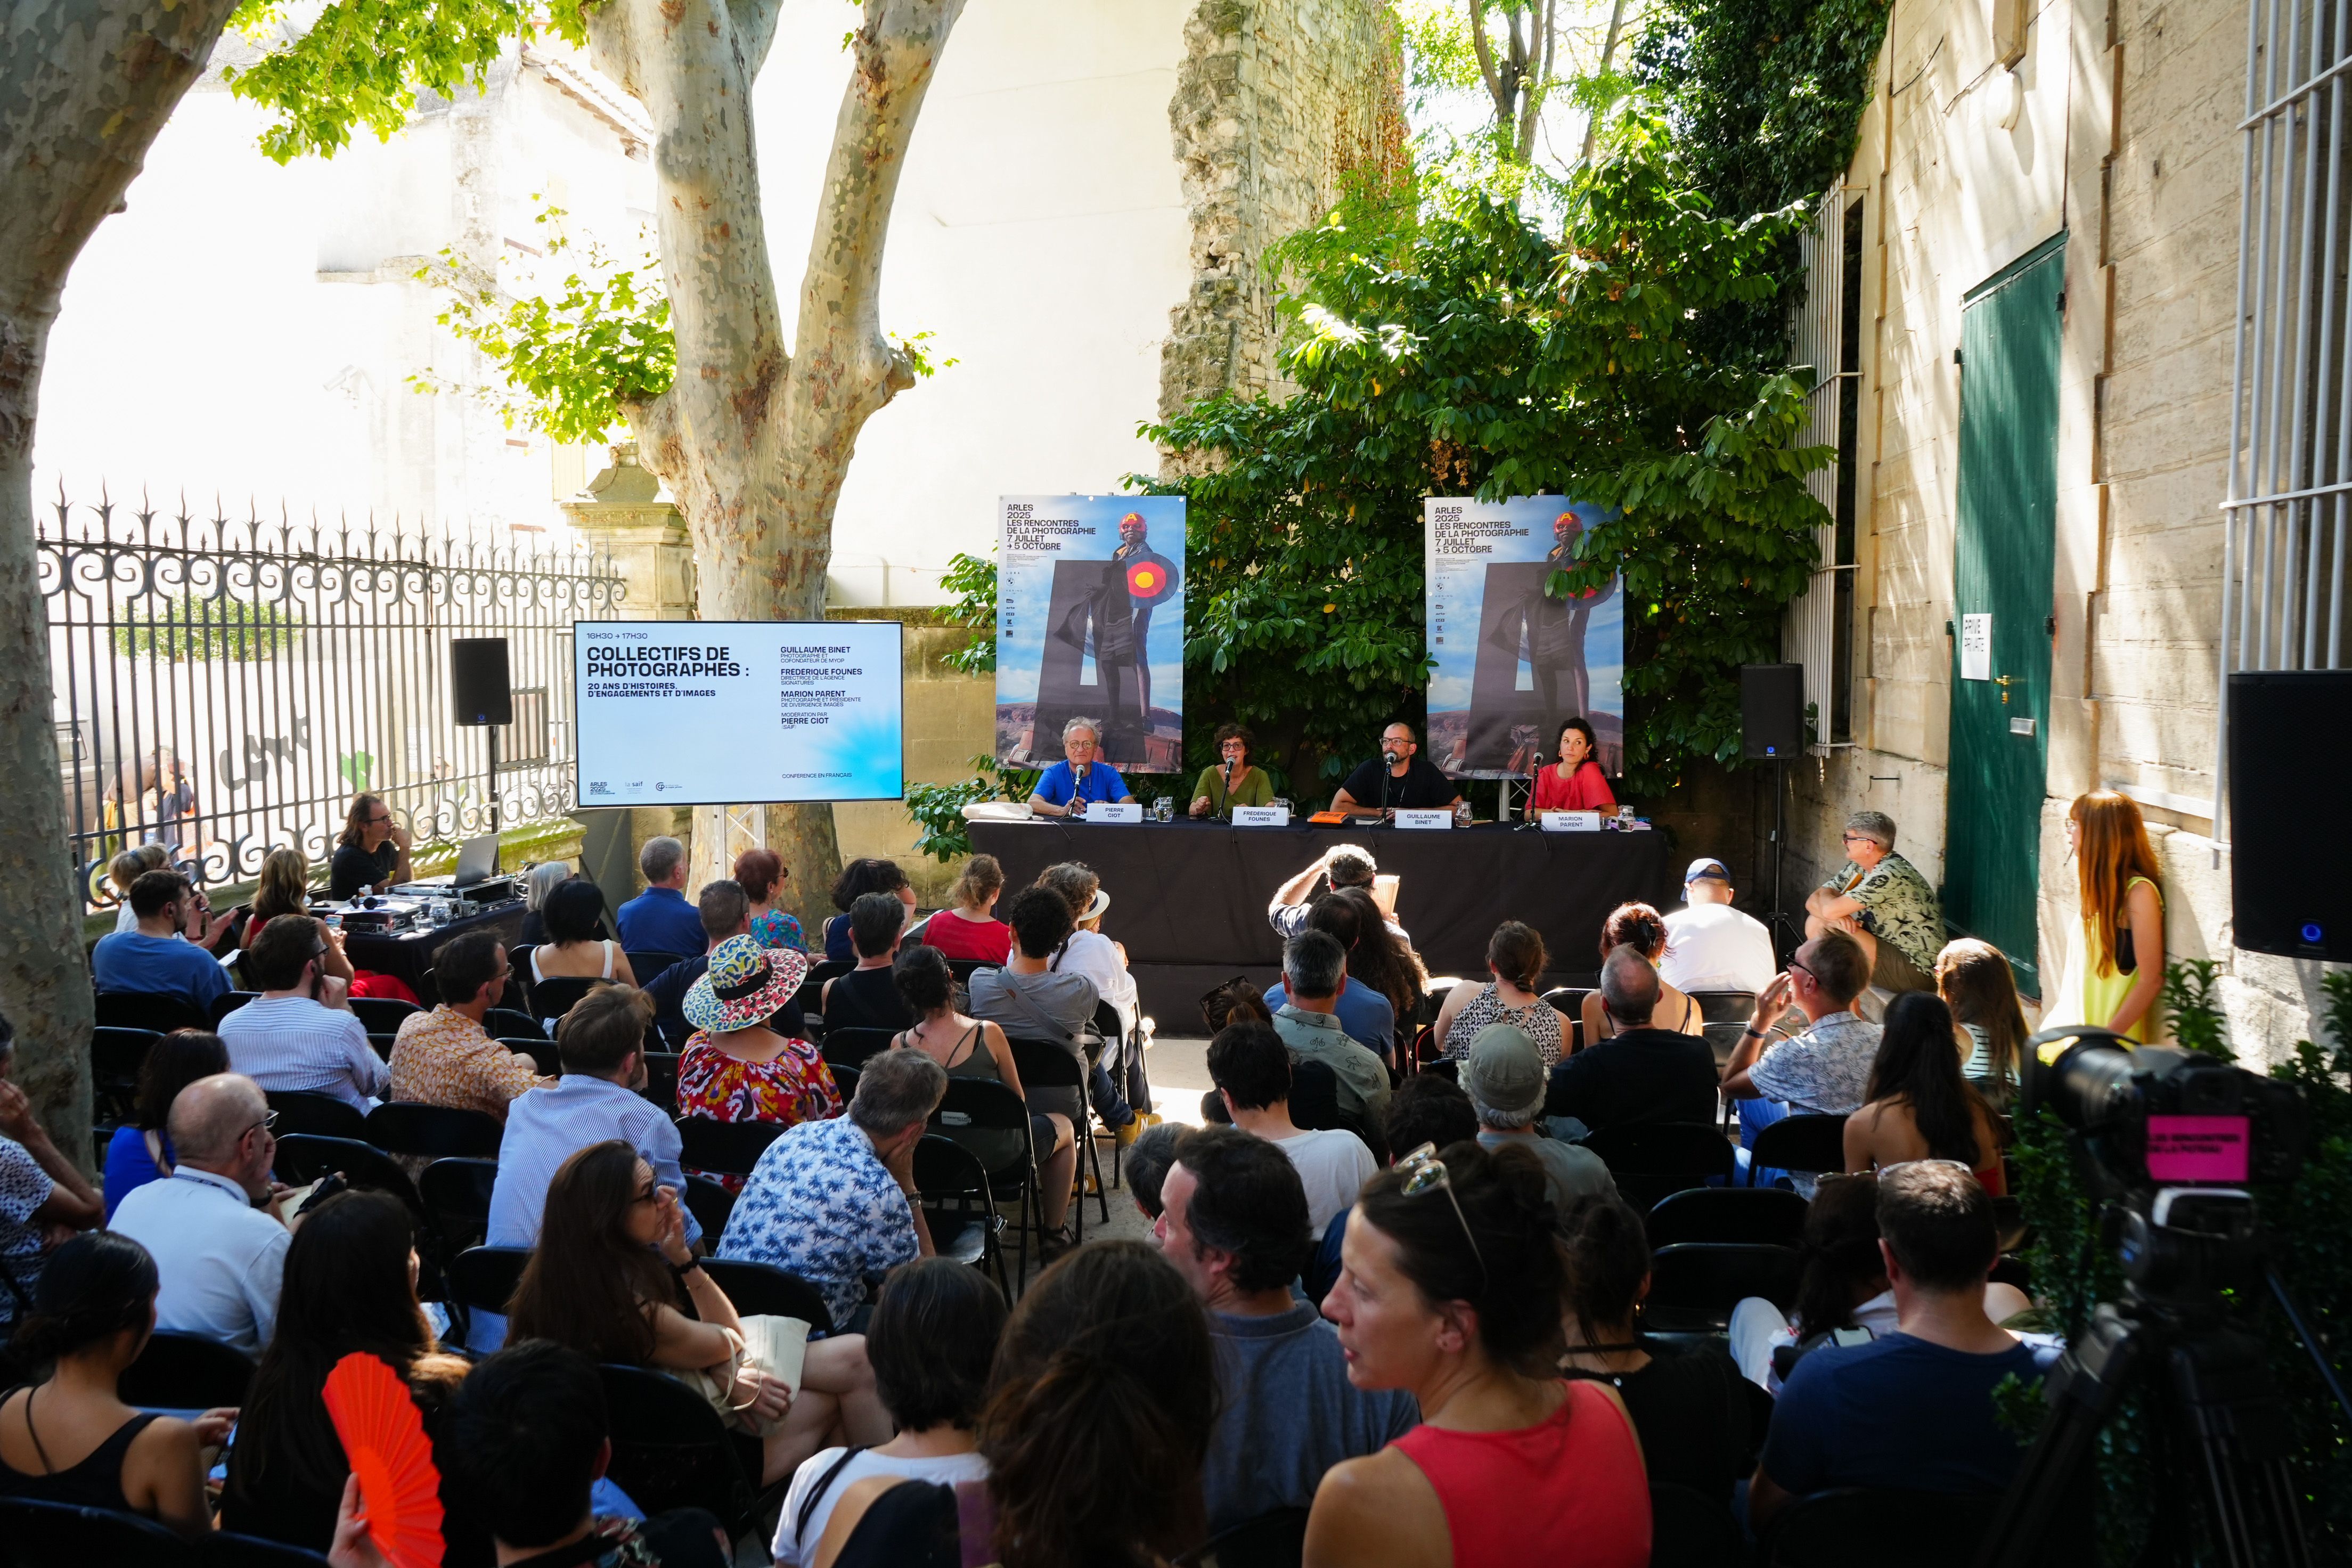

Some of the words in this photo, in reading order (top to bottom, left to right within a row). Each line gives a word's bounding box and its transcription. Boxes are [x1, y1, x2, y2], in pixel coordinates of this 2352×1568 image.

[1461, 528, 1529, 537] PHOTOGRAPHIE
[587, 647, 701, 661] COLLECTIFS
[707, 647, 730, 661] DE
[587, 663, 740, 677] PHOTOGRAPHES
